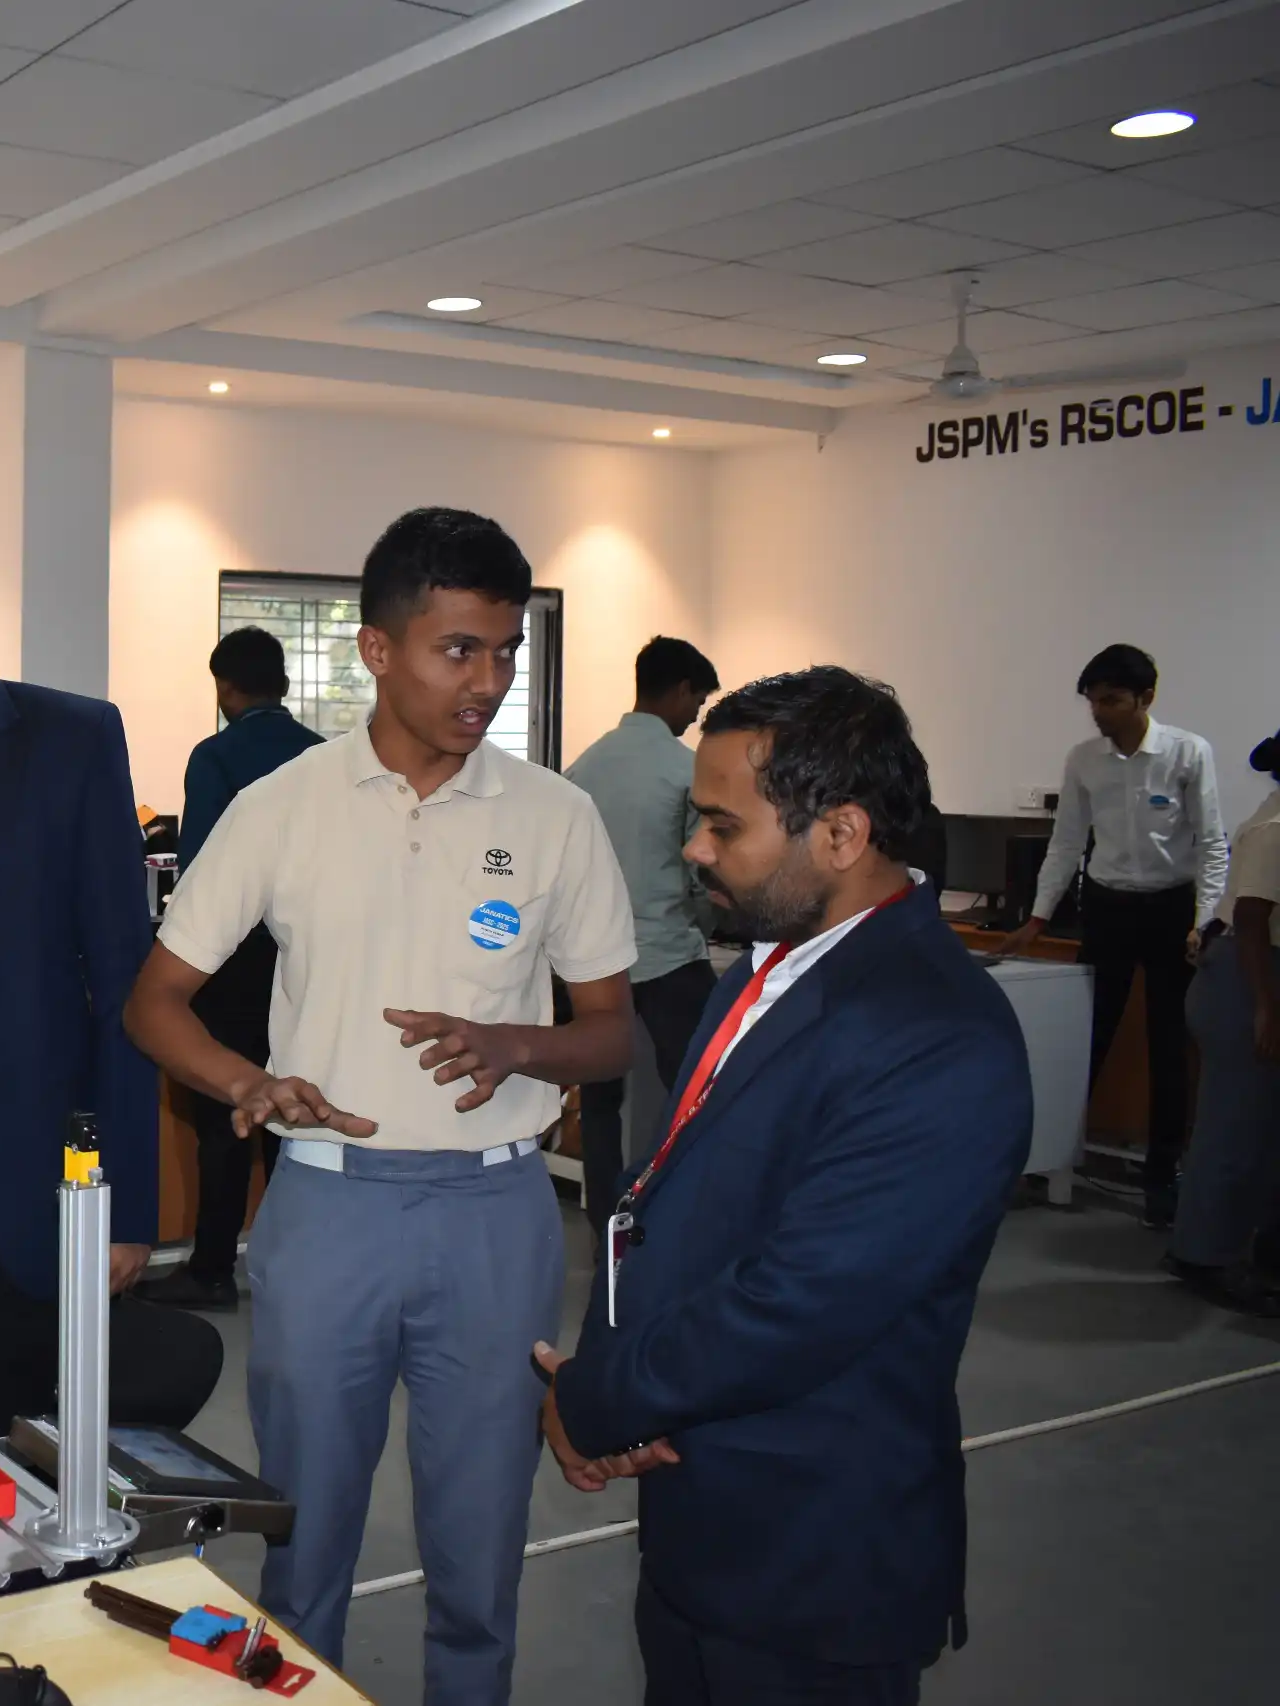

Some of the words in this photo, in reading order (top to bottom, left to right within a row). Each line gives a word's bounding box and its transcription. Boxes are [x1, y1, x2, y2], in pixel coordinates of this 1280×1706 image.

[916, 408, 1049, 463] JSPM's
[1060, 387, 1205, 446] RSCOE
[482, 867, 513, 876] TOYOTA
[479, 908, 519, 924] JANATICS
